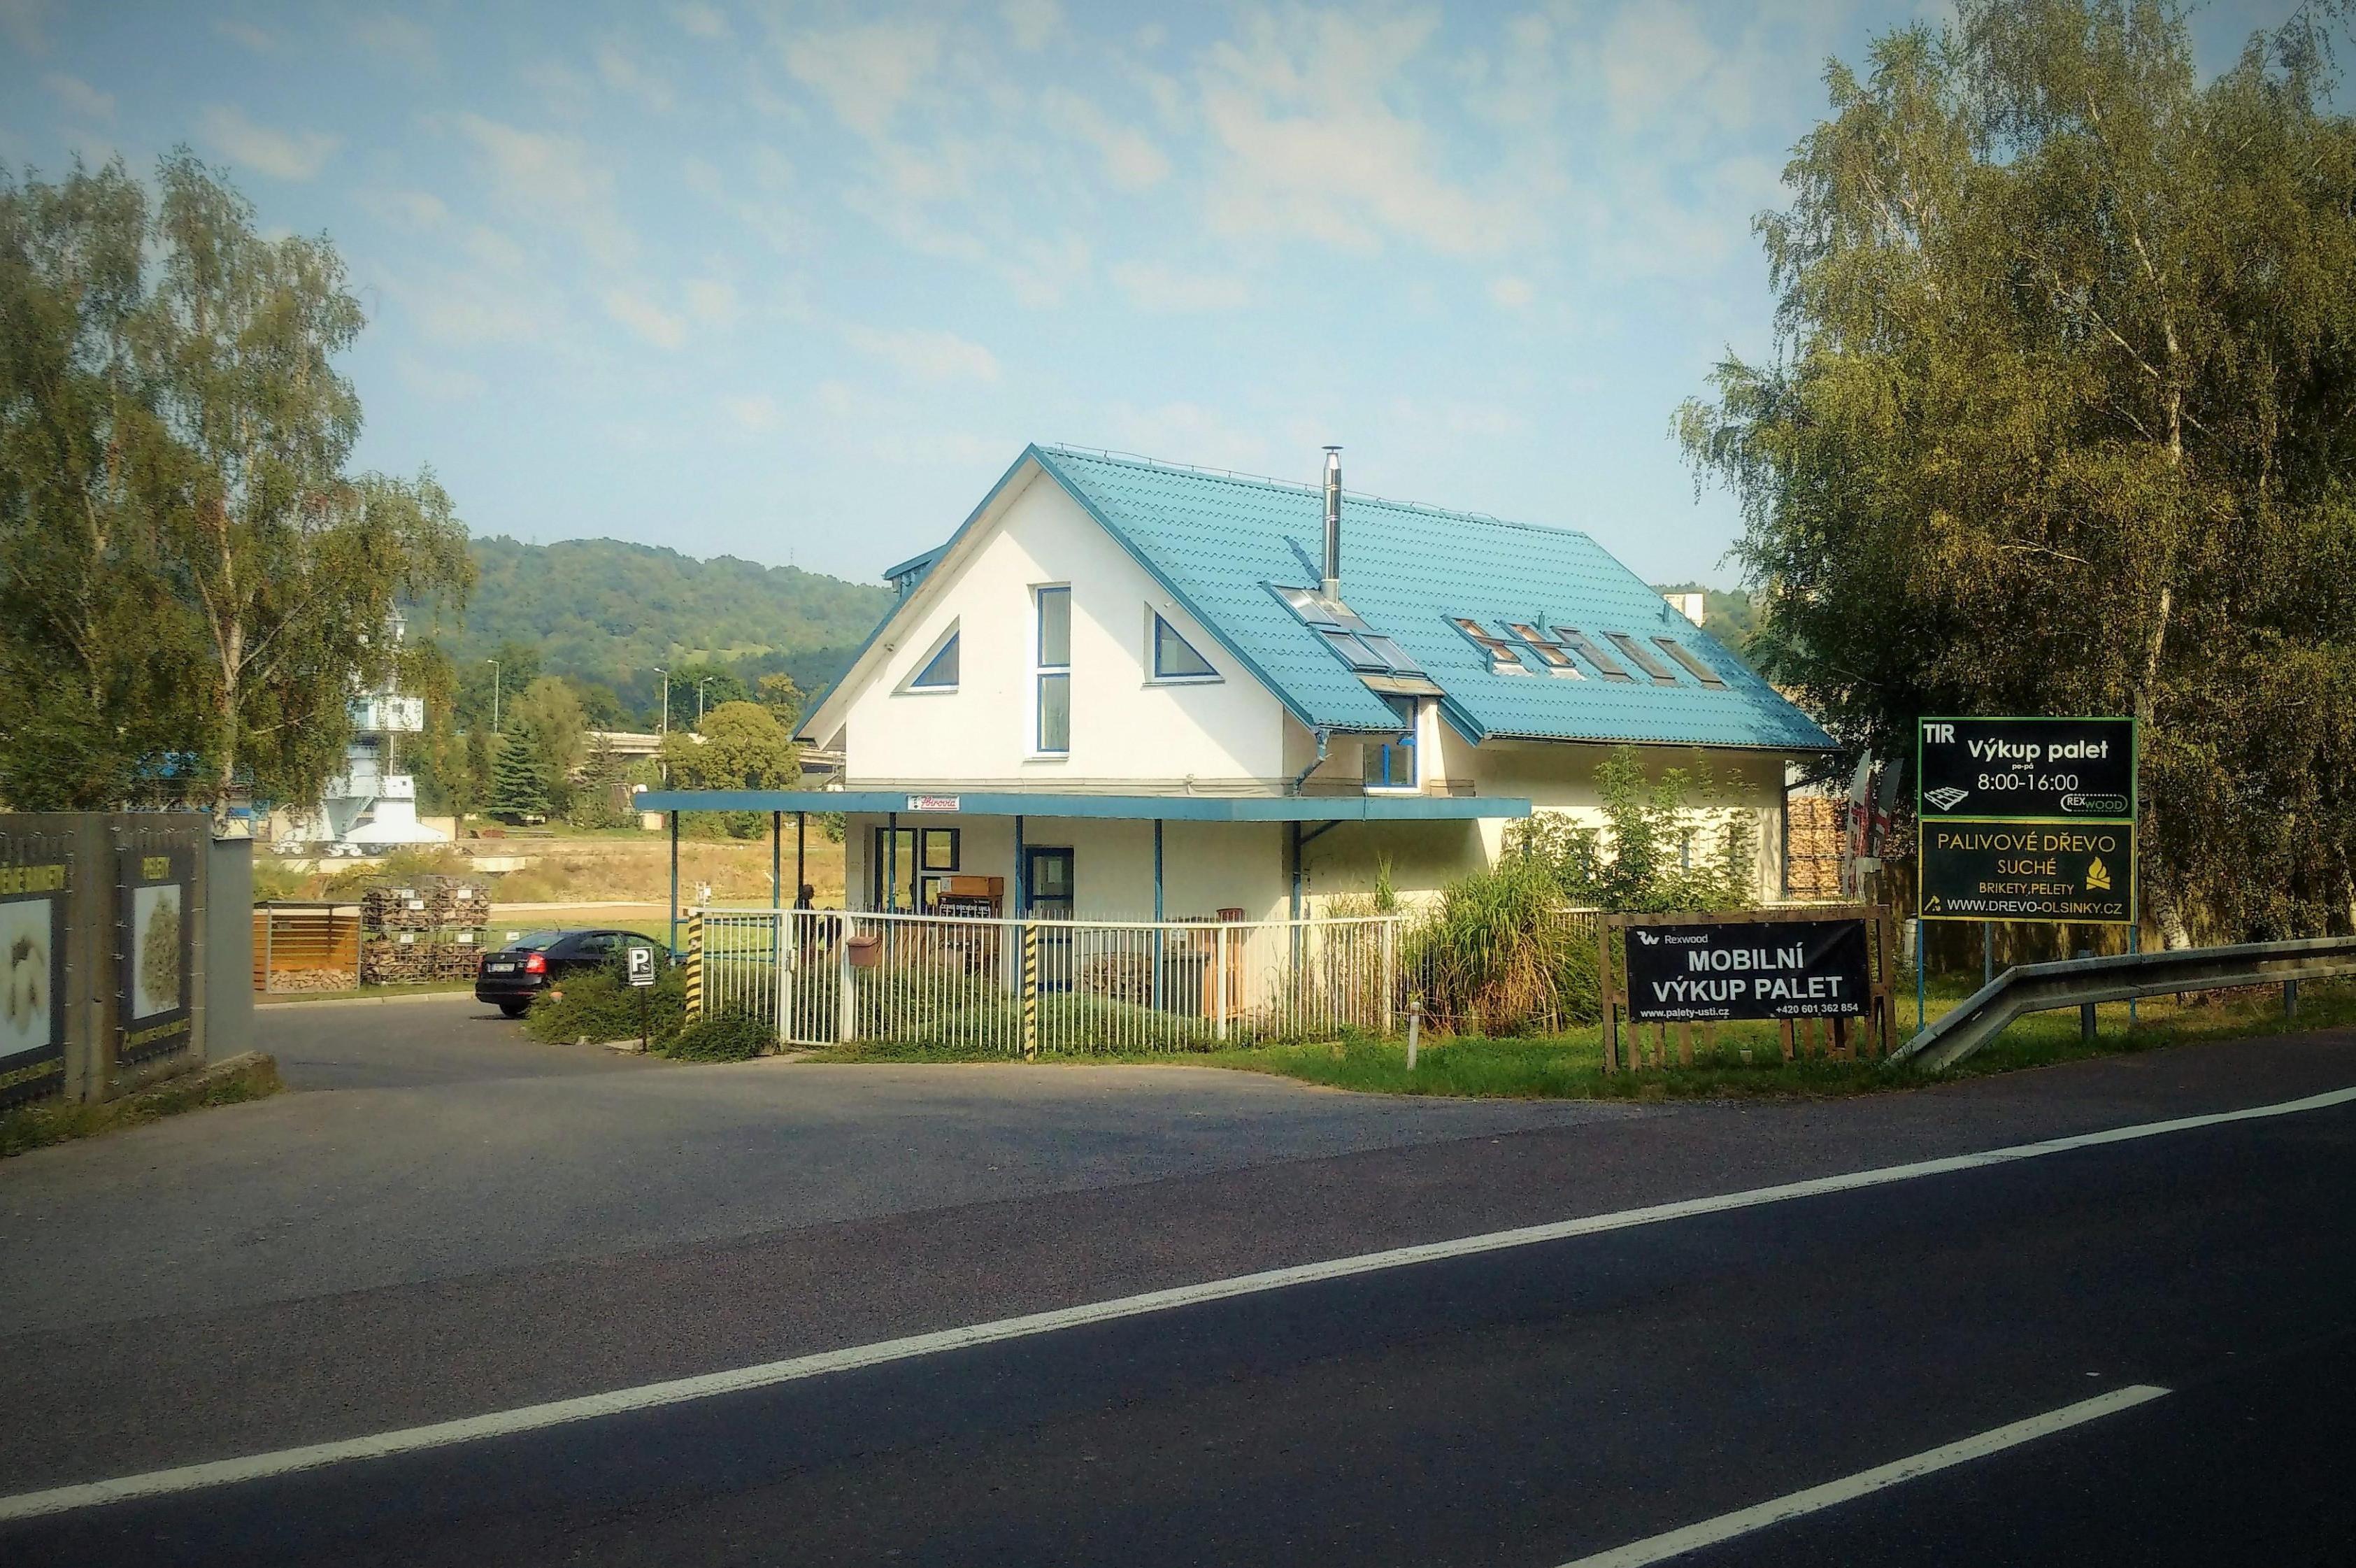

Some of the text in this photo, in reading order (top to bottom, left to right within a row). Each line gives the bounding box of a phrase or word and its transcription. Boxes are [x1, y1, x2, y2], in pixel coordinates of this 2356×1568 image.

[1923, 724, 1955, 744] TIR
[1968, 738, 2108, 762] Výkup palet
[1978, 774, 2078, 791] 8:00-16:00
[1938, 830, 2116, 853] PALIVOVÉ DŘEVO
[1997, 857, 2057, 875] SUCHÉ
[1947, 899, 2123, 915] WWW.DREVO-OLSINKY.CZ
[1664, 934, 1708, 944] Rexwood
[631, 950, 649, 972] P
[1688, 942, 1804, 972] MOBILNÍ
[1652, 976, 1843, 1002] VÝKUP PALET
[1641, 1007, 1730, 1018] www.palety-usti.cz
[1776, 1003, 1859, 1014] +420 601 362 854
